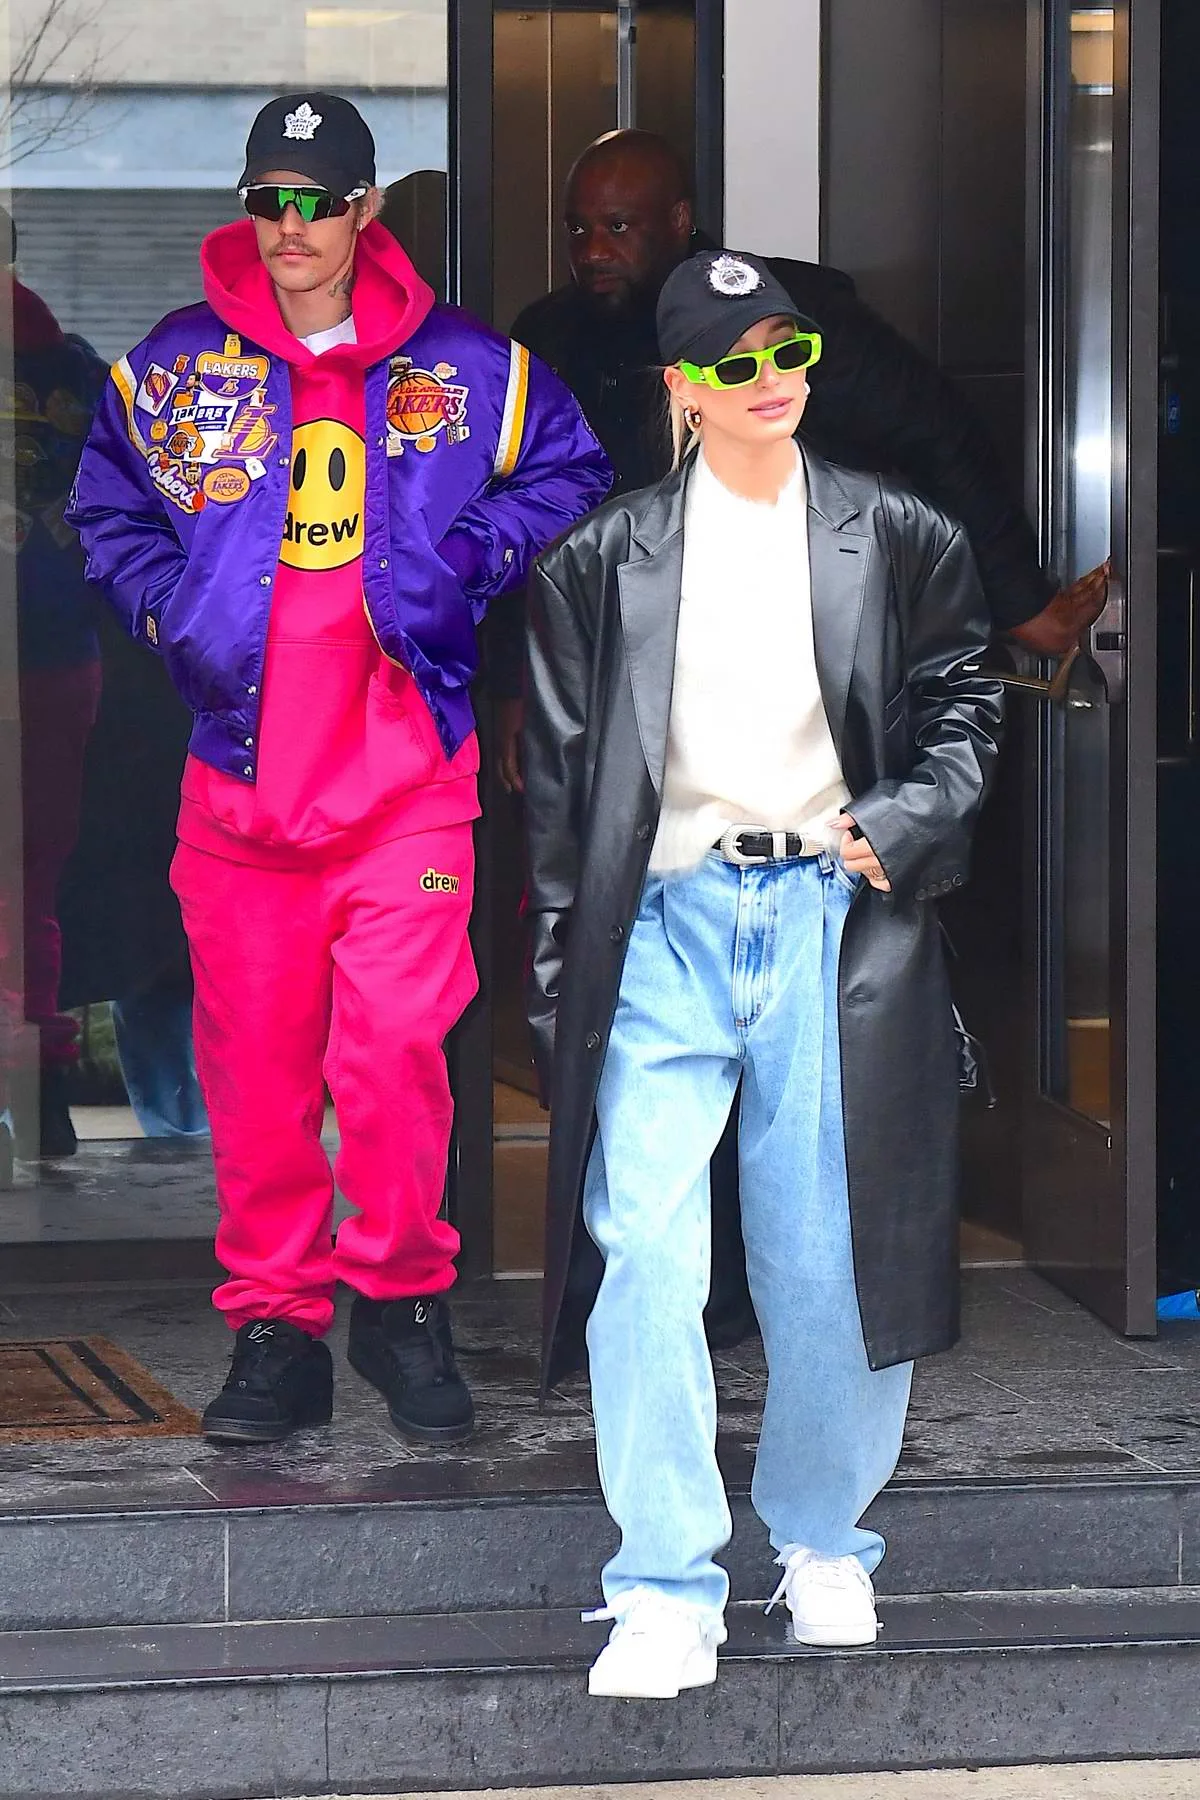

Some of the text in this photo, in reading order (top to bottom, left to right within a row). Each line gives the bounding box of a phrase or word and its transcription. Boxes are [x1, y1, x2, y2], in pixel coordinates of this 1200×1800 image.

[203, 361, 258, 377] LAKERS
[387, 395, 465, 425] AKERS
[282, 511, 359, 547] drew
[422, 871, 459, 892] drew
